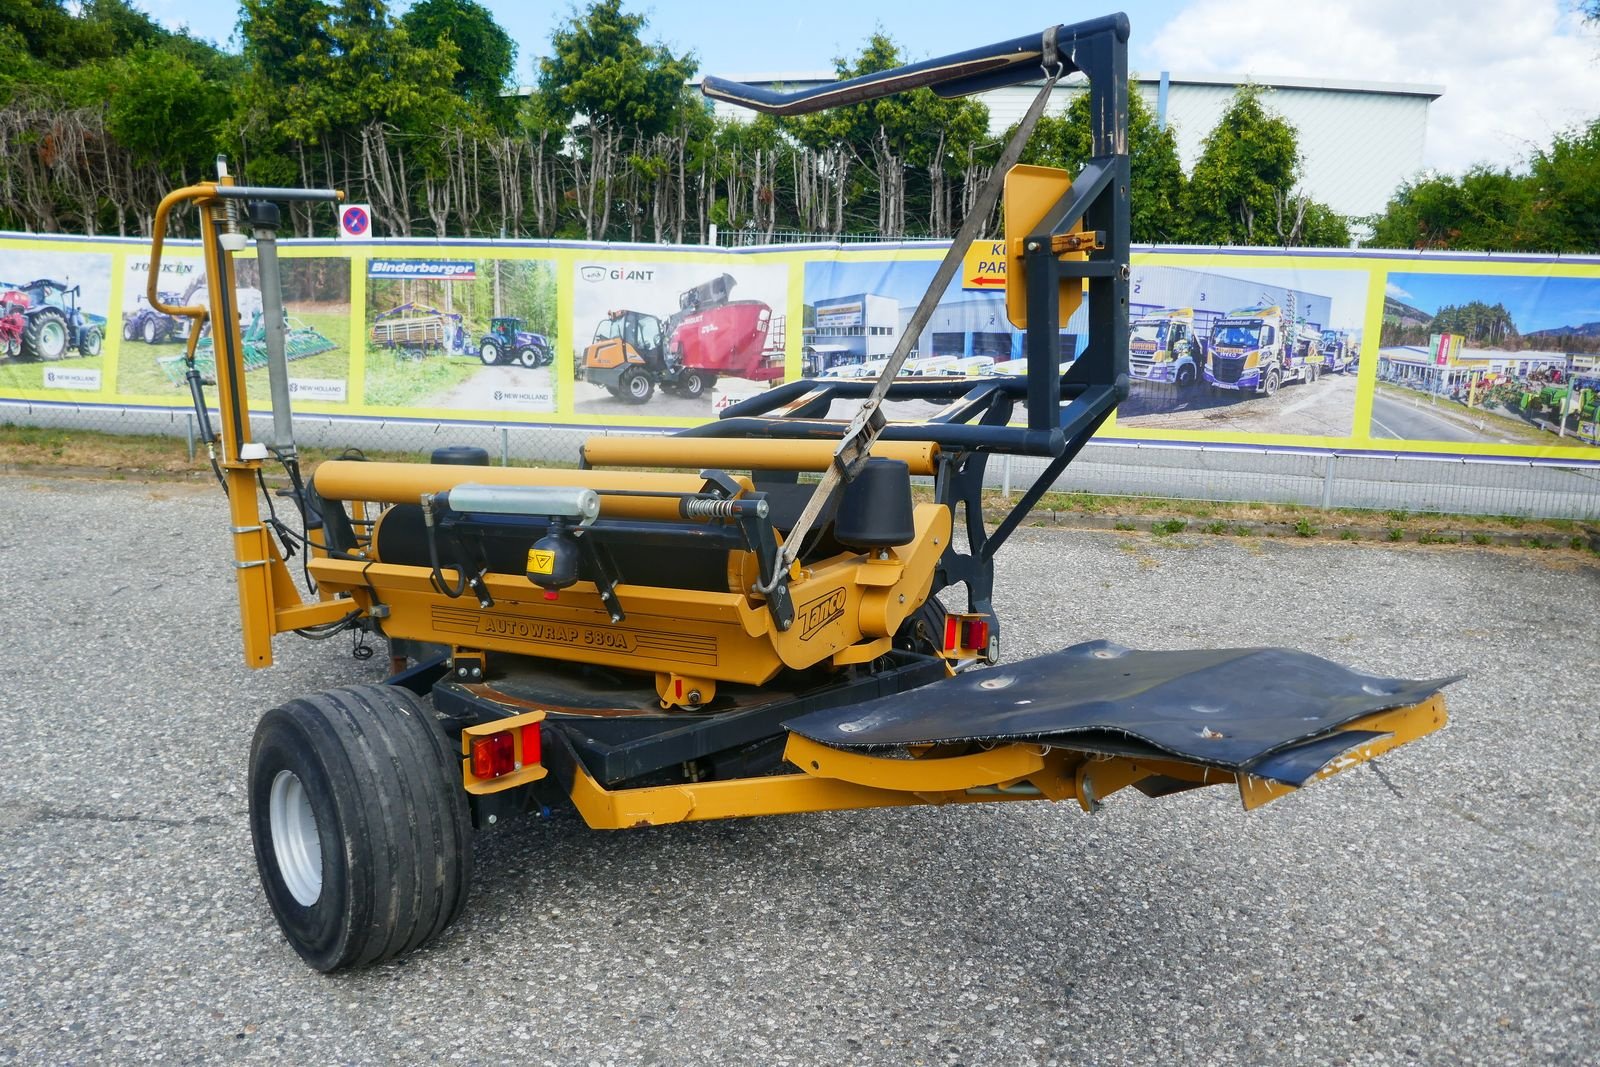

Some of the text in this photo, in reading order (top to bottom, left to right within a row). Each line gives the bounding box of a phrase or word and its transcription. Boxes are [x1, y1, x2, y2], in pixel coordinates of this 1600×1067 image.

[131, 262, 193, 274] JOKIN
[371, 262, 473, 275] Binderberger
[1134, 284, 1141, 294] 2
[1200, 293, 1206, 301] 3
[990, 317, 995, 325] 2
[798, 587, 847, 636] Tanco
[486, 618, 628, 649] AUTOWRAP 580A
